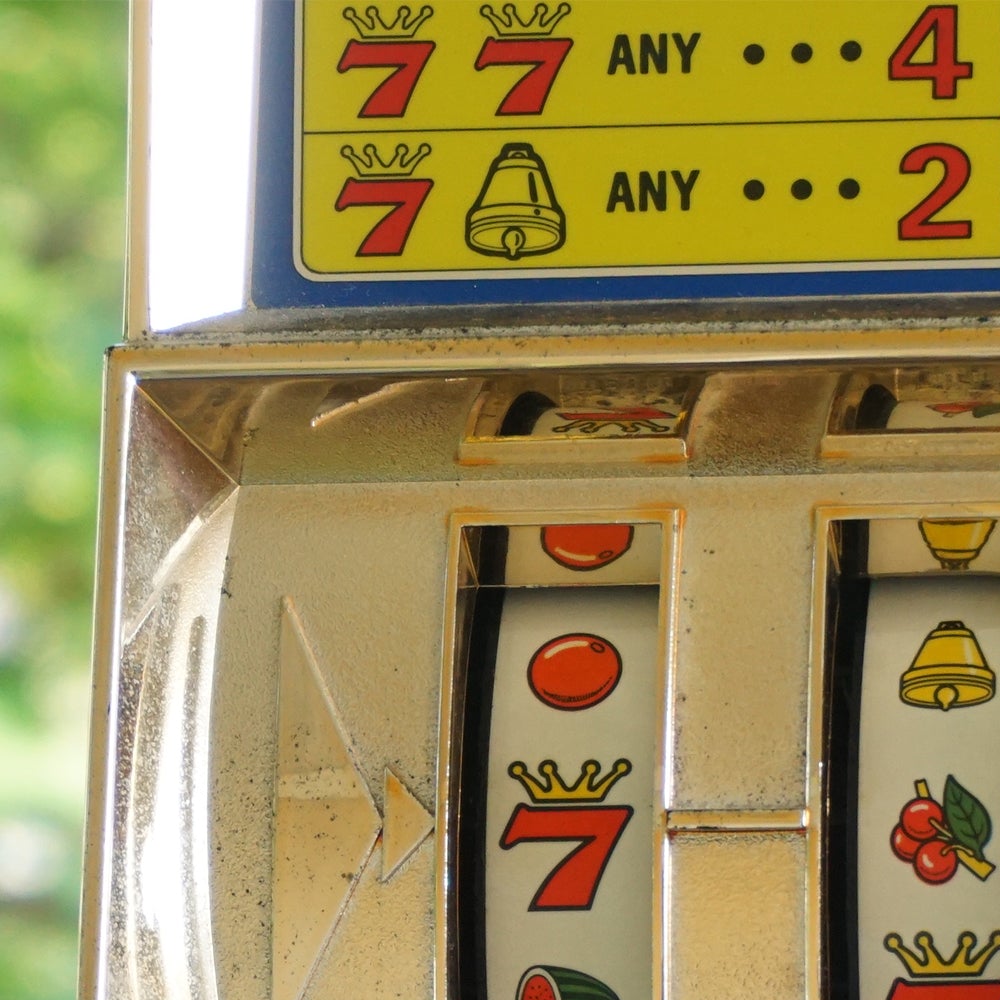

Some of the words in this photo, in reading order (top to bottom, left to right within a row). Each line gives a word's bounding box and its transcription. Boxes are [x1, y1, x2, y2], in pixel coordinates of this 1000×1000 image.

[336, 39, 437, 118] 7
[474, 37, 574, 117] 7
[606, 32, 701, 75] ANY
[888, 4, 973, 100] 4
[334, 177, 435, 257] 7
[605, 169, 700, 213] ANY
[897, 142, 972, 241] 2
[499, 804, 635, 912] 7
